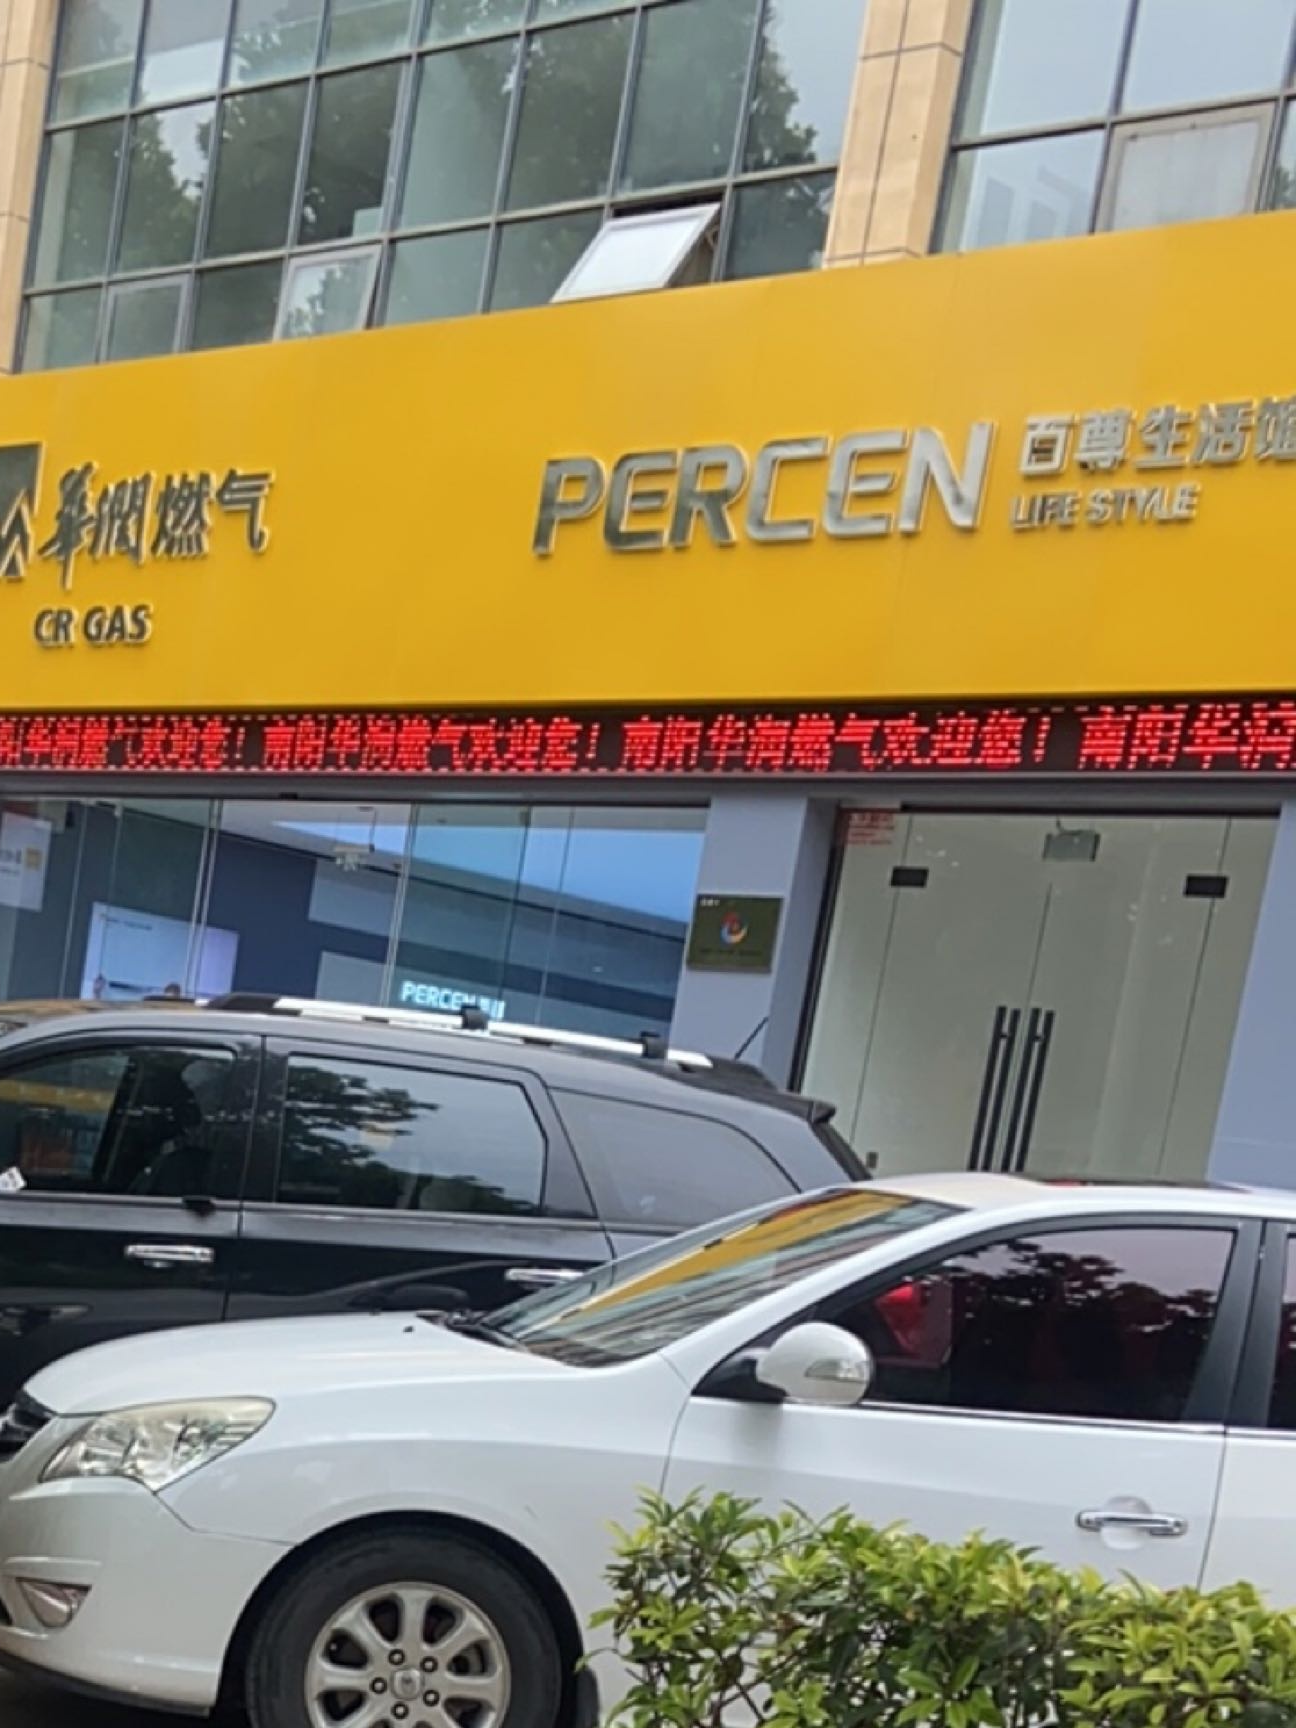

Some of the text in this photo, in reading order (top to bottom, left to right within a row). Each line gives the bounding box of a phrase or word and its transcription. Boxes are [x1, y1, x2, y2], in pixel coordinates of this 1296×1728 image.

[533, 419, 998, 556] PERCEN
[1011, 482, 1201, 531] LIFE STYLE
[34, 603, 154, 648] CR GAS
